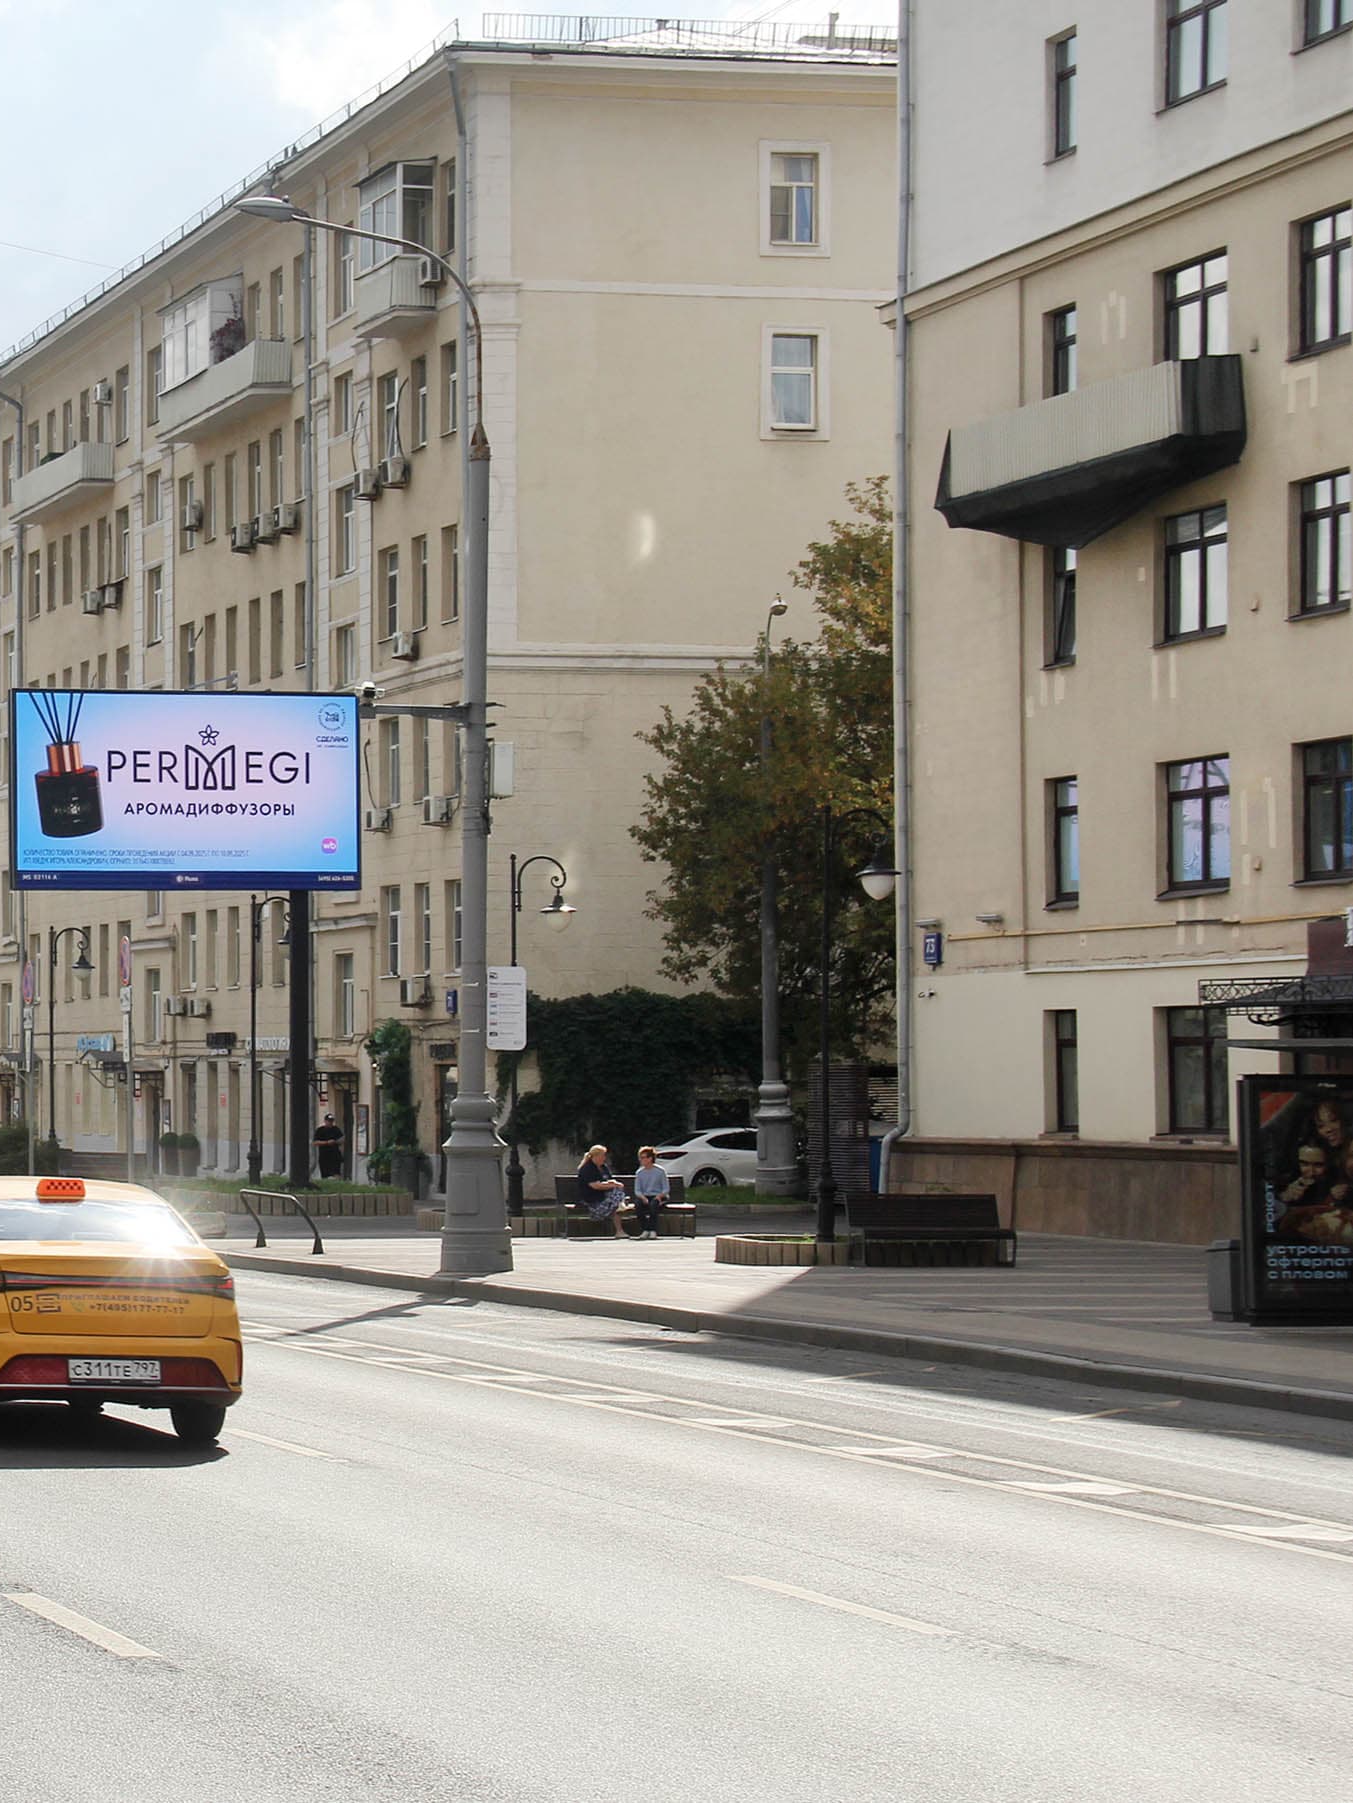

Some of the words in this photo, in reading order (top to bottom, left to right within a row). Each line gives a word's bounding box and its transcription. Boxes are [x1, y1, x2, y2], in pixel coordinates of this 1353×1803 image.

[107, 744, 310, 791] PERMEGI
[124, 802, 295, 817] АРОМАДИФФУЗОРЫ
[1266, 1245, 1350, 1257] устроить
[1281, 1270, 1348, 1279] пловом
[10, 1296, 33, 1312] 05
[73, 1362, 131, 1377] С311ТЕ
[133, 1362, 156, 1375] 797
